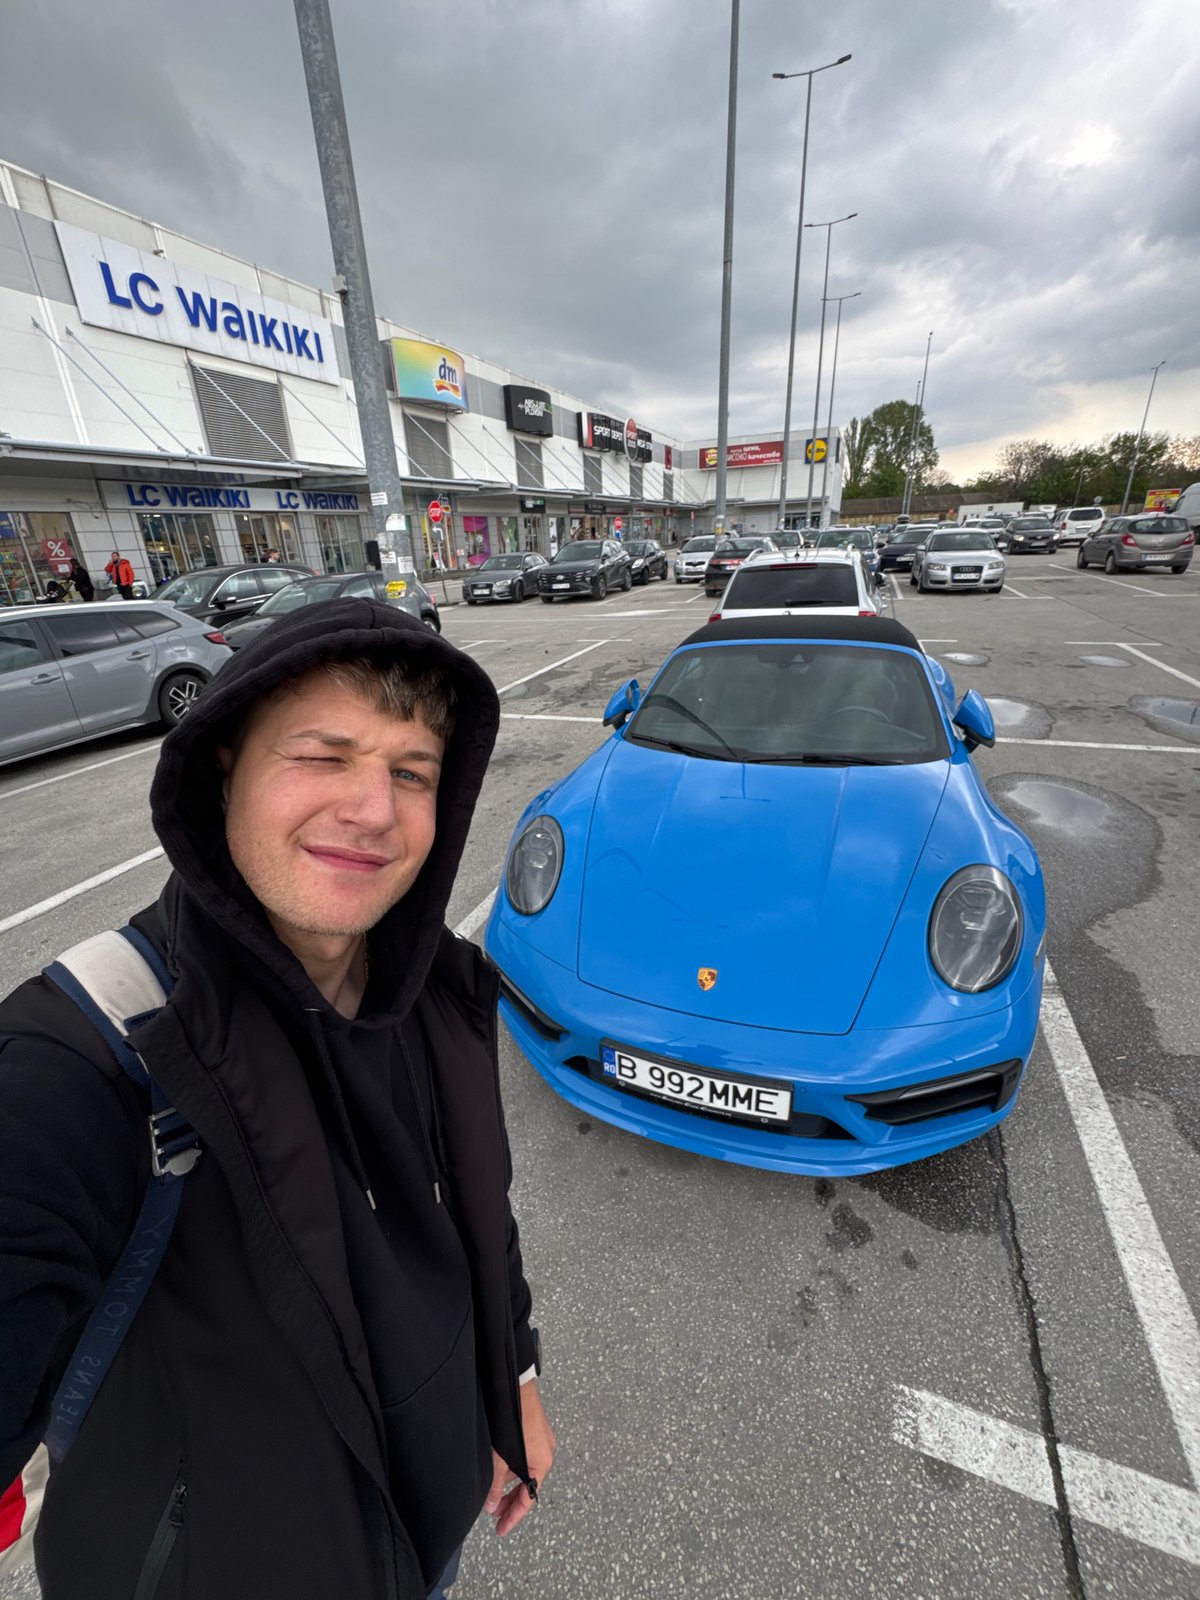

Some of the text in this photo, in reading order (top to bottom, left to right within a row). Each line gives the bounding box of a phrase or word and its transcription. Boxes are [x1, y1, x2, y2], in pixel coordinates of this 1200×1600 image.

[99, 261, 164, 315] LC
[438, 357, 457, 384] dm
[125, 483, 161, 507] LC
[276, 491, 300, 509] LC
[430, 508, 442, 517] STOP
[603, 1062, 615, 1074] RO
[617, 1053, 637, 1080] B
